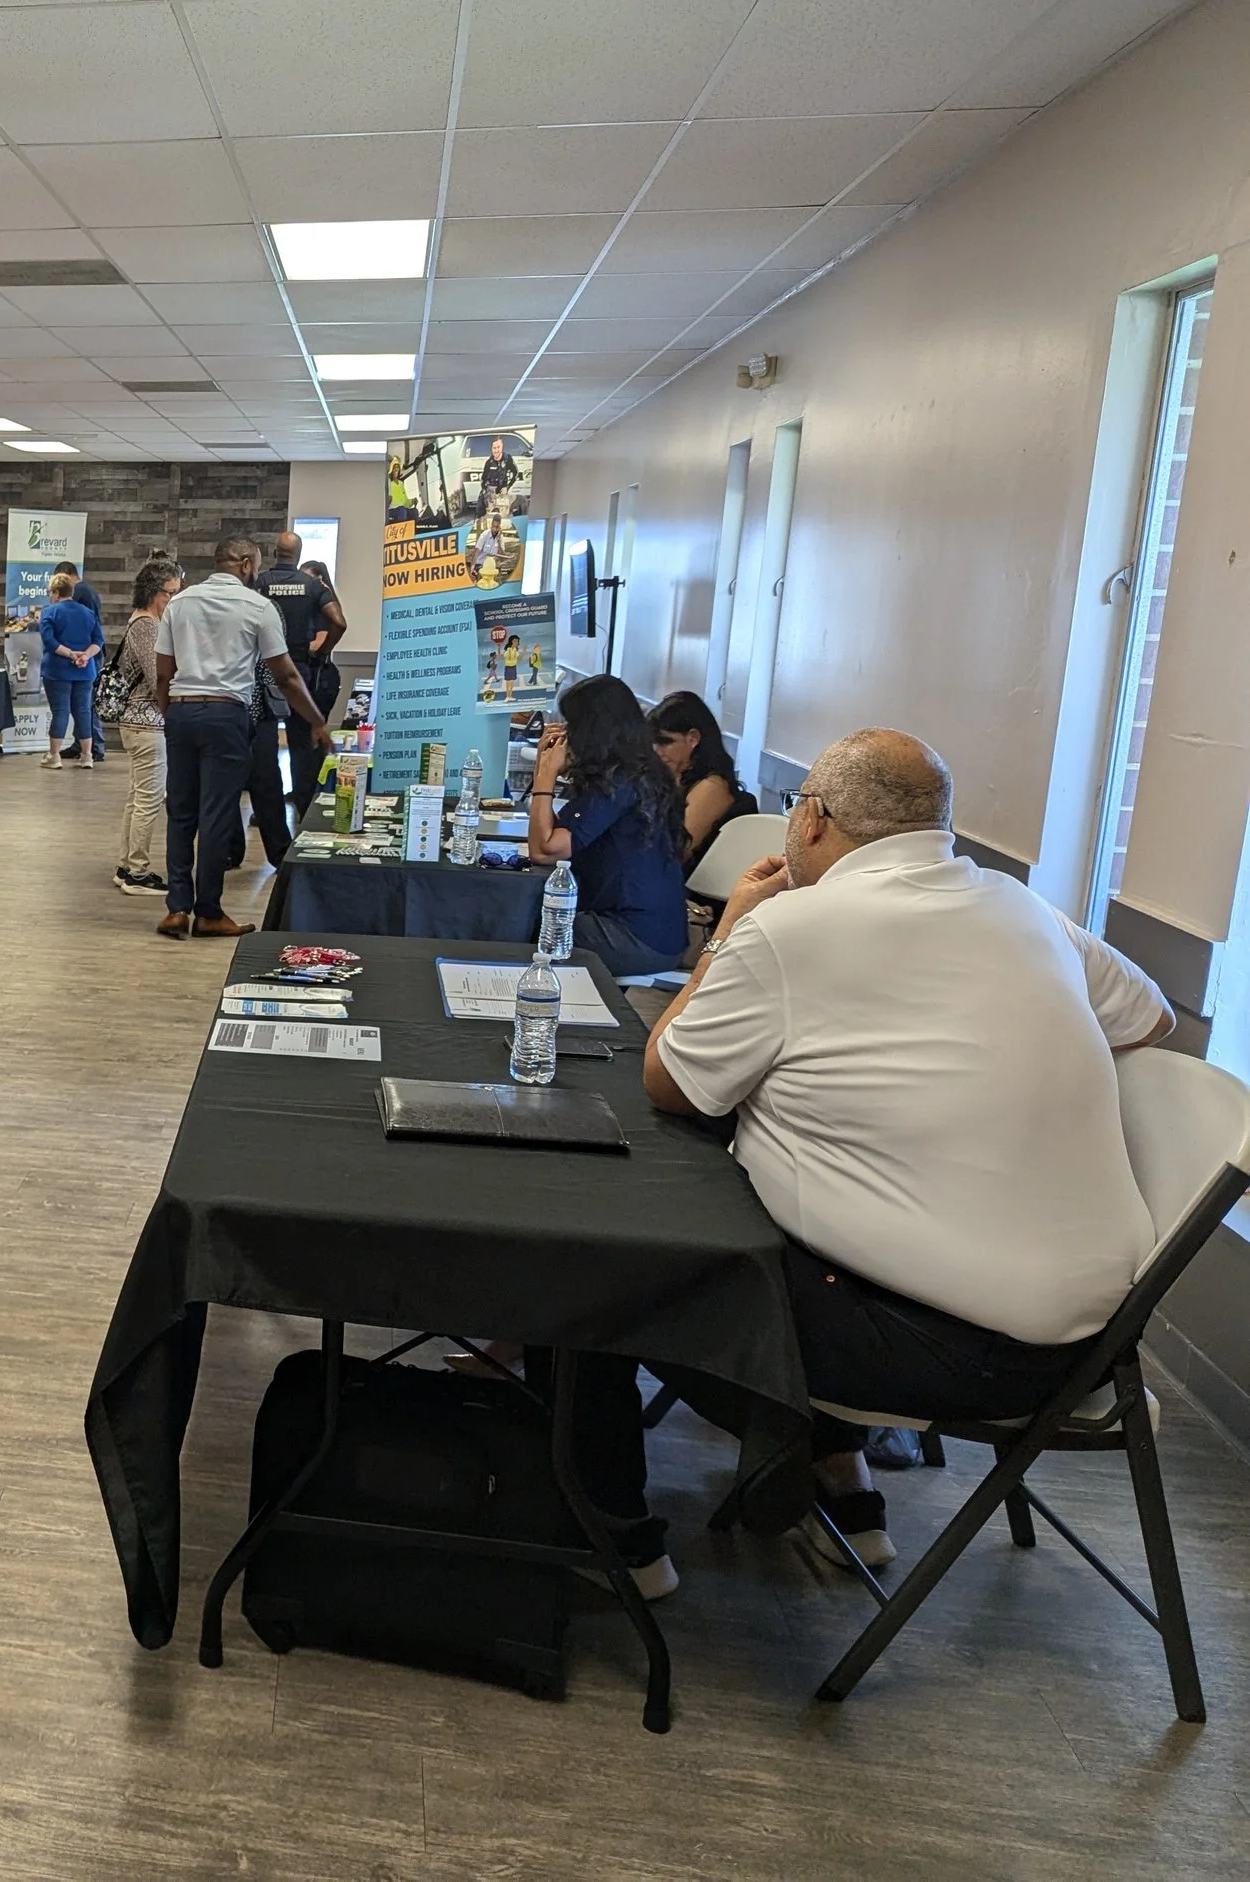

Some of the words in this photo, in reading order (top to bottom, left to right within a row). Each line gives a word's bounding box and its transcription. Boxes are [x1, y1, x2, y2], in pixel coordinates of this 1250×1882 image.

[386, 526, 398, 540] City
[399, 522, 408, 538] of
[384, 535, 457, 564] ITUSVILLE
[20, 571, 42, 582] Your
[414, 562, 465, 583] HIRING
[18, 585, 47, 598] begins
[415, 607, 434, 617] DENTAL
[439, 603, 454, 614] VISION
[455, 600, 474, 612] COVERA
[388, 630, 412, 640] FLEXIBLE
[412, 626, 436, 638] SPENDING
[438, 624, 458, 634] ACCOUNT
[492, 630, 506, 640] STOP
[386, 650, 412, 660] EMPLOYEE
[414, 648, 432, 658] HEALTH
[432, 646, 448, 656] CLINIC
[386, 670, 405, 680] HEALTH
[410, 668, 436, 678] WELLNESS
[436, 665, 462, 676] PROGRAMS
[386, 691, 396, 700] LIFE
[398, 689, 425, 700] INSURANCE
[426, 687, 450, 698] COVERAGE
[400, 709, 422, 720] VACATION
[428, 708, 446, 718] HOLIDAY
[447, 706, 462, 716] LEAVE
[14, 728, 36, 736] NOW
[384, 730, 404, 740] TUITION
[404, 728, 444, 739] REIMBURSEMENT
[382, 751, 404, 760] PENSION
[404, 750, 417, 758] PLAN
[382, 770, 412, 779] RETIREMENT
